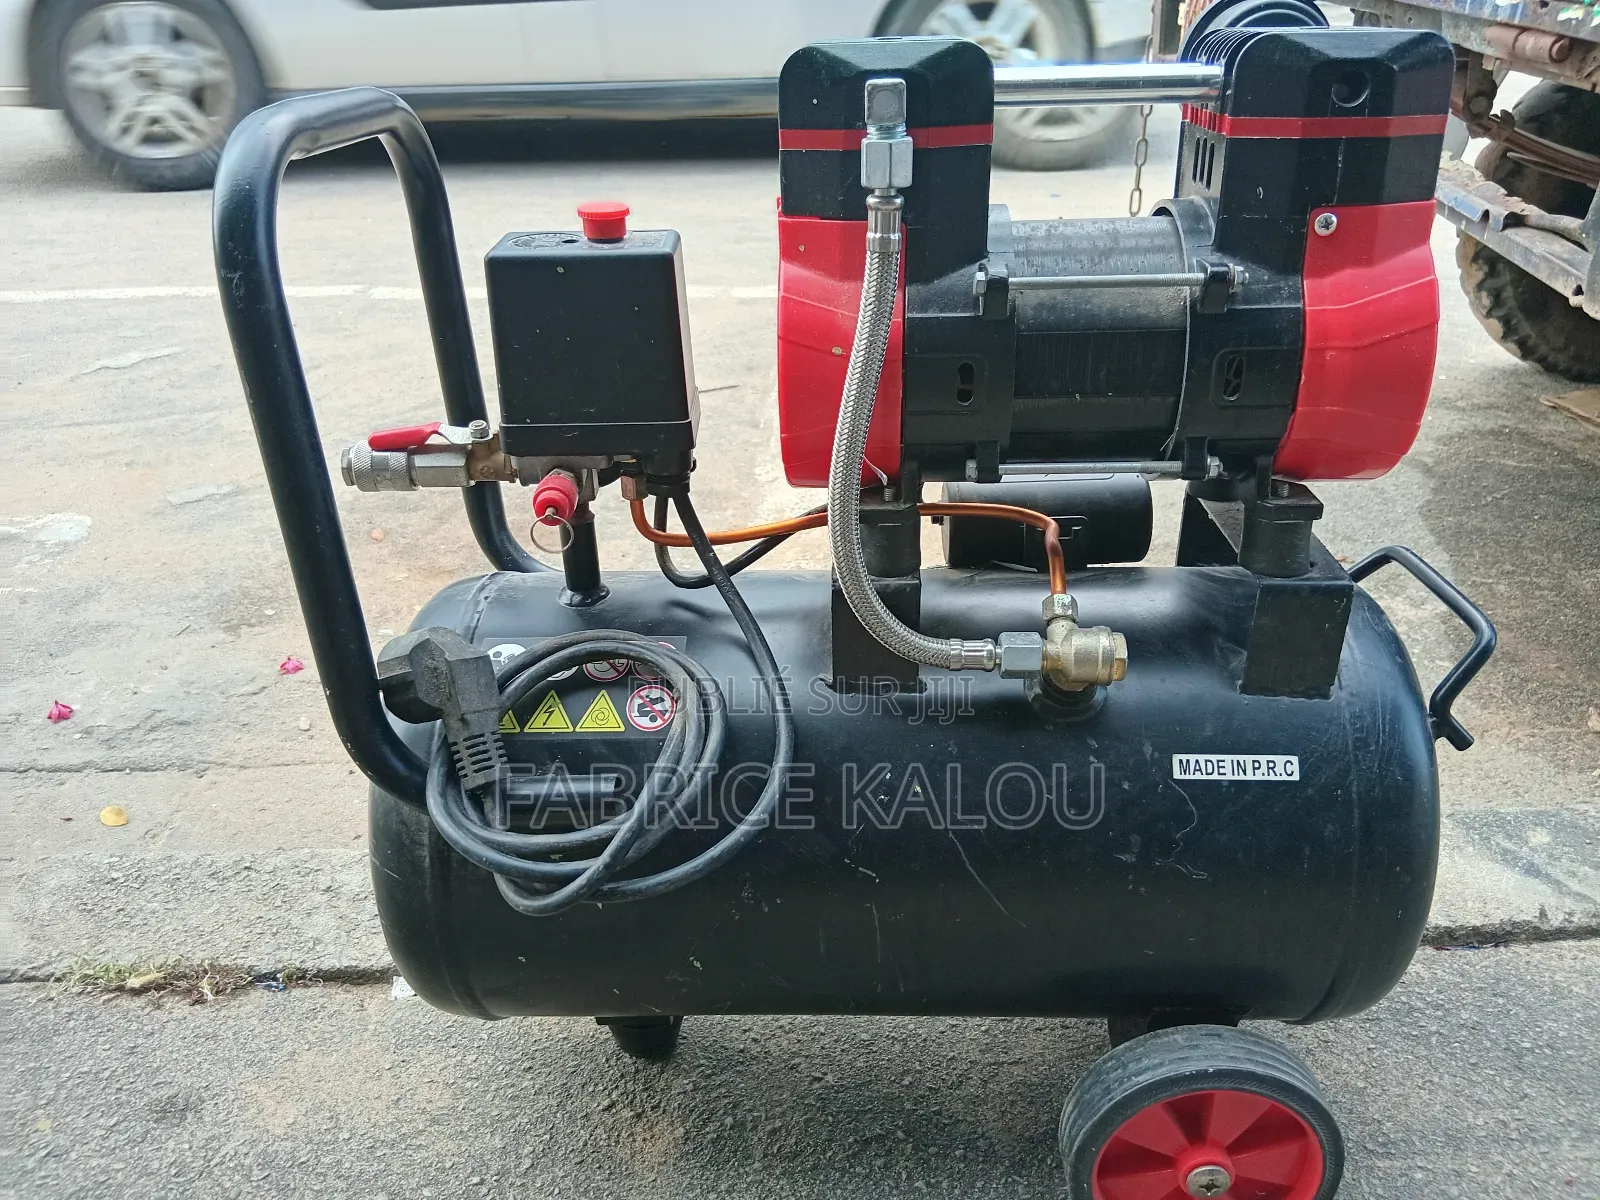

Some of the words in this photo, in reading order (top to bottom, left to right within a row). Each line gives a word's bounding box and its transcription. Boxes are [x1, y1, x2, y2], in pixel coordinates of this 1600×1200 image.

[1178, 758, 1226, 776] MADE
[1231, 759, 1247, 777] IN
[1251, 759, 1295, 777] P.R.C
